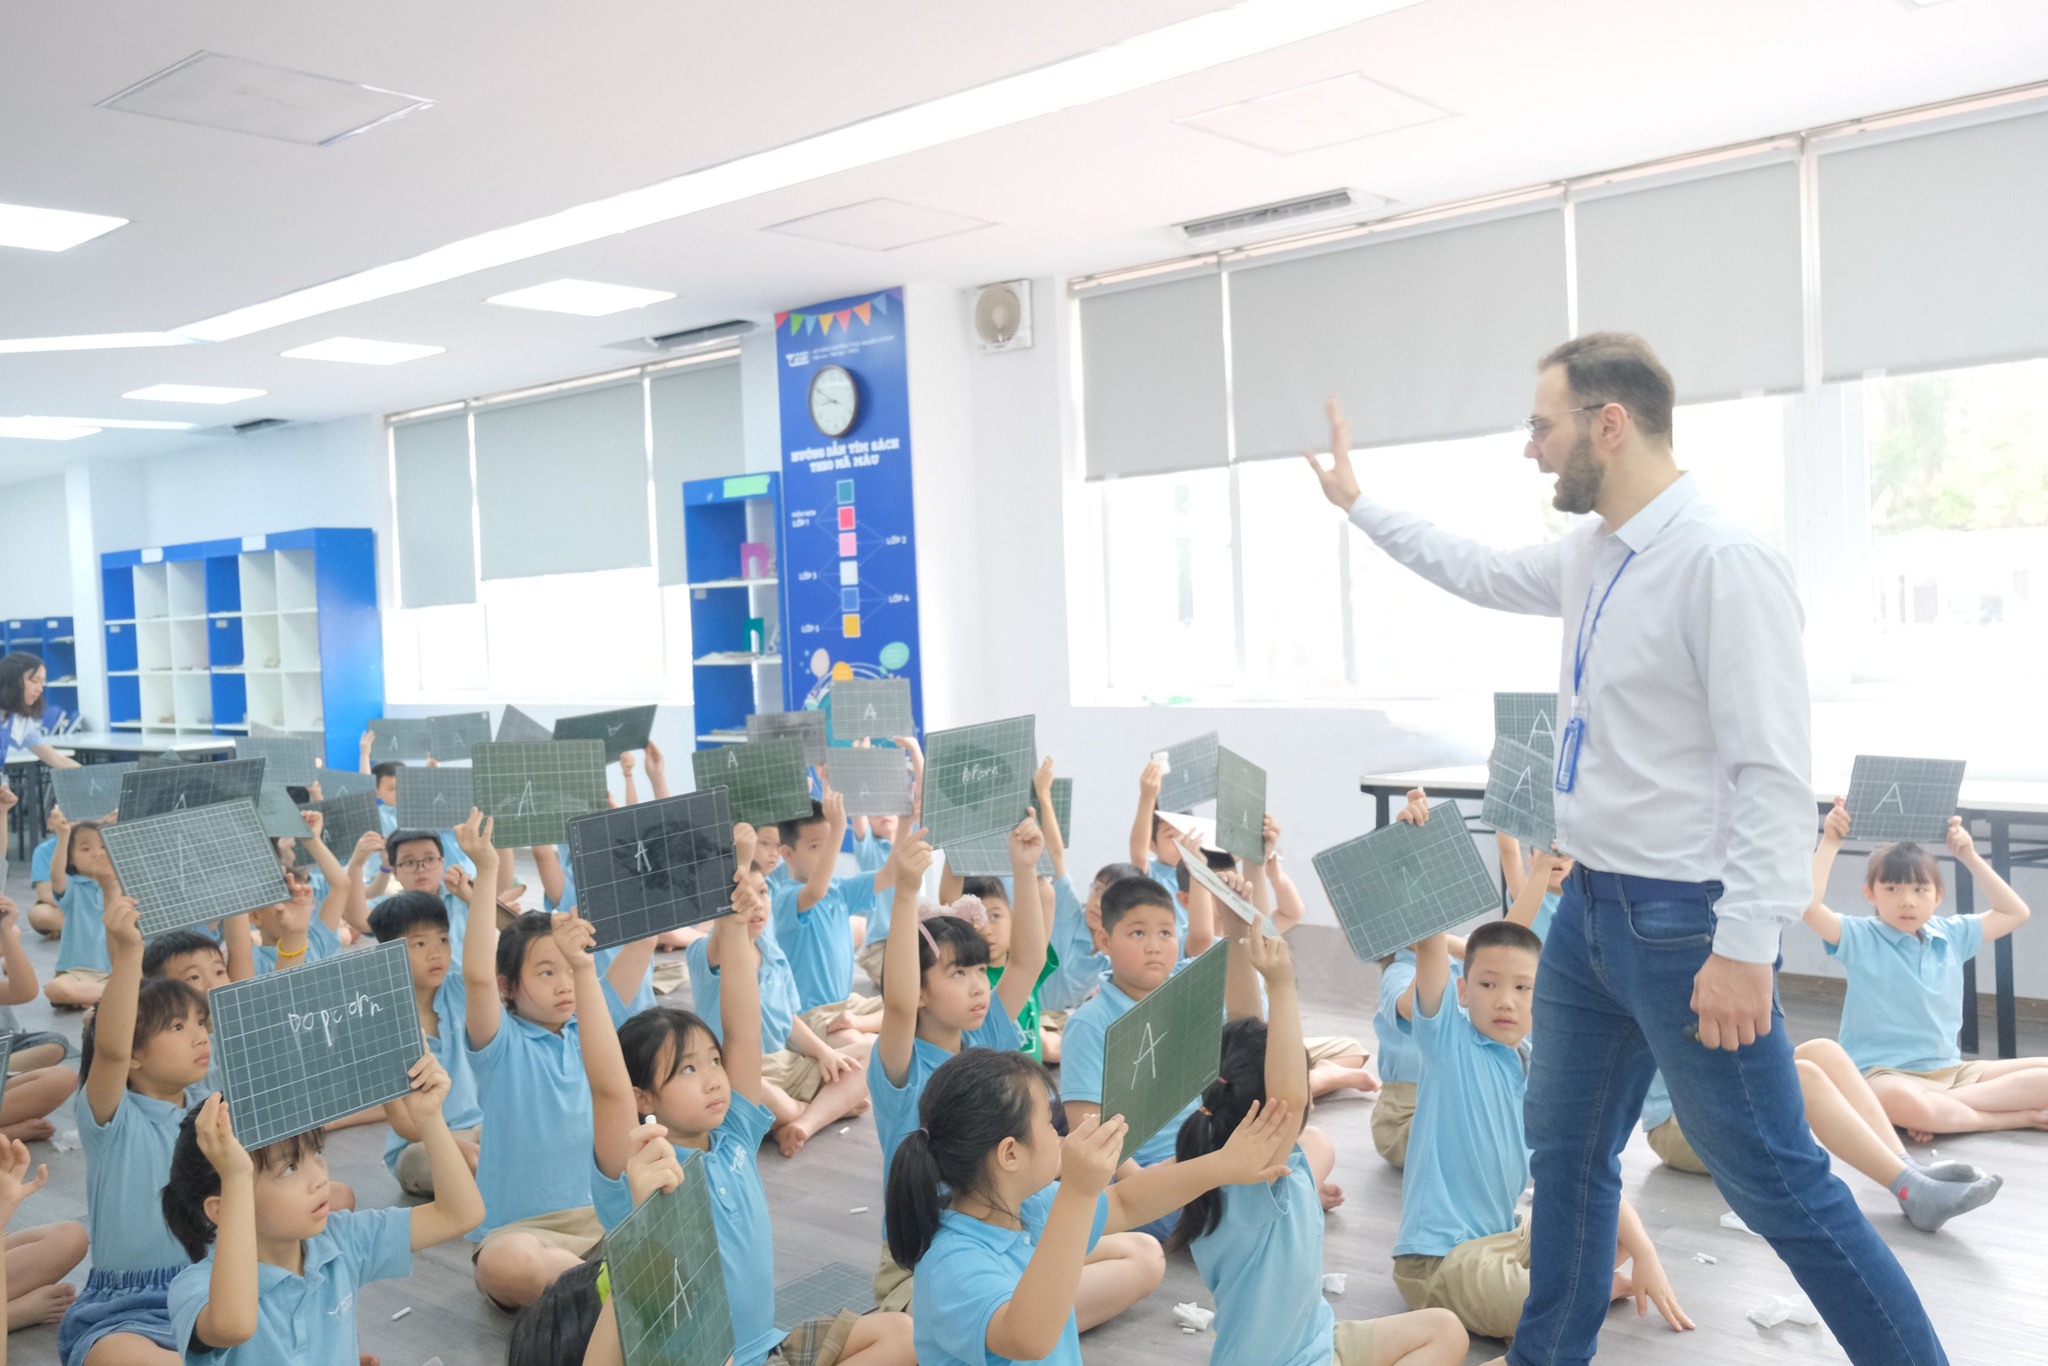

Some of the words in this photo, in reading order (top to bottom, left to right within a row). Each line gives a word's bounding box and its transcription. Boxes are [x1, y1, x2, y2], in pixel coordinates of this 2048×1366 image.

[863, 703, 877, 721] A
[1526, 709, 1556, 748] A
[388, 735, 399, 752] A
[727, 750, 739, 769] A
[517, 780, 537, 817] A
[1508, 765, 1534, 810] A
[1871, 782, 1904, 815] A
[634, 839, 652, 873] A
[1131, 1022, 1169, 1091] A
[670, 1258, 693, 1330] A
